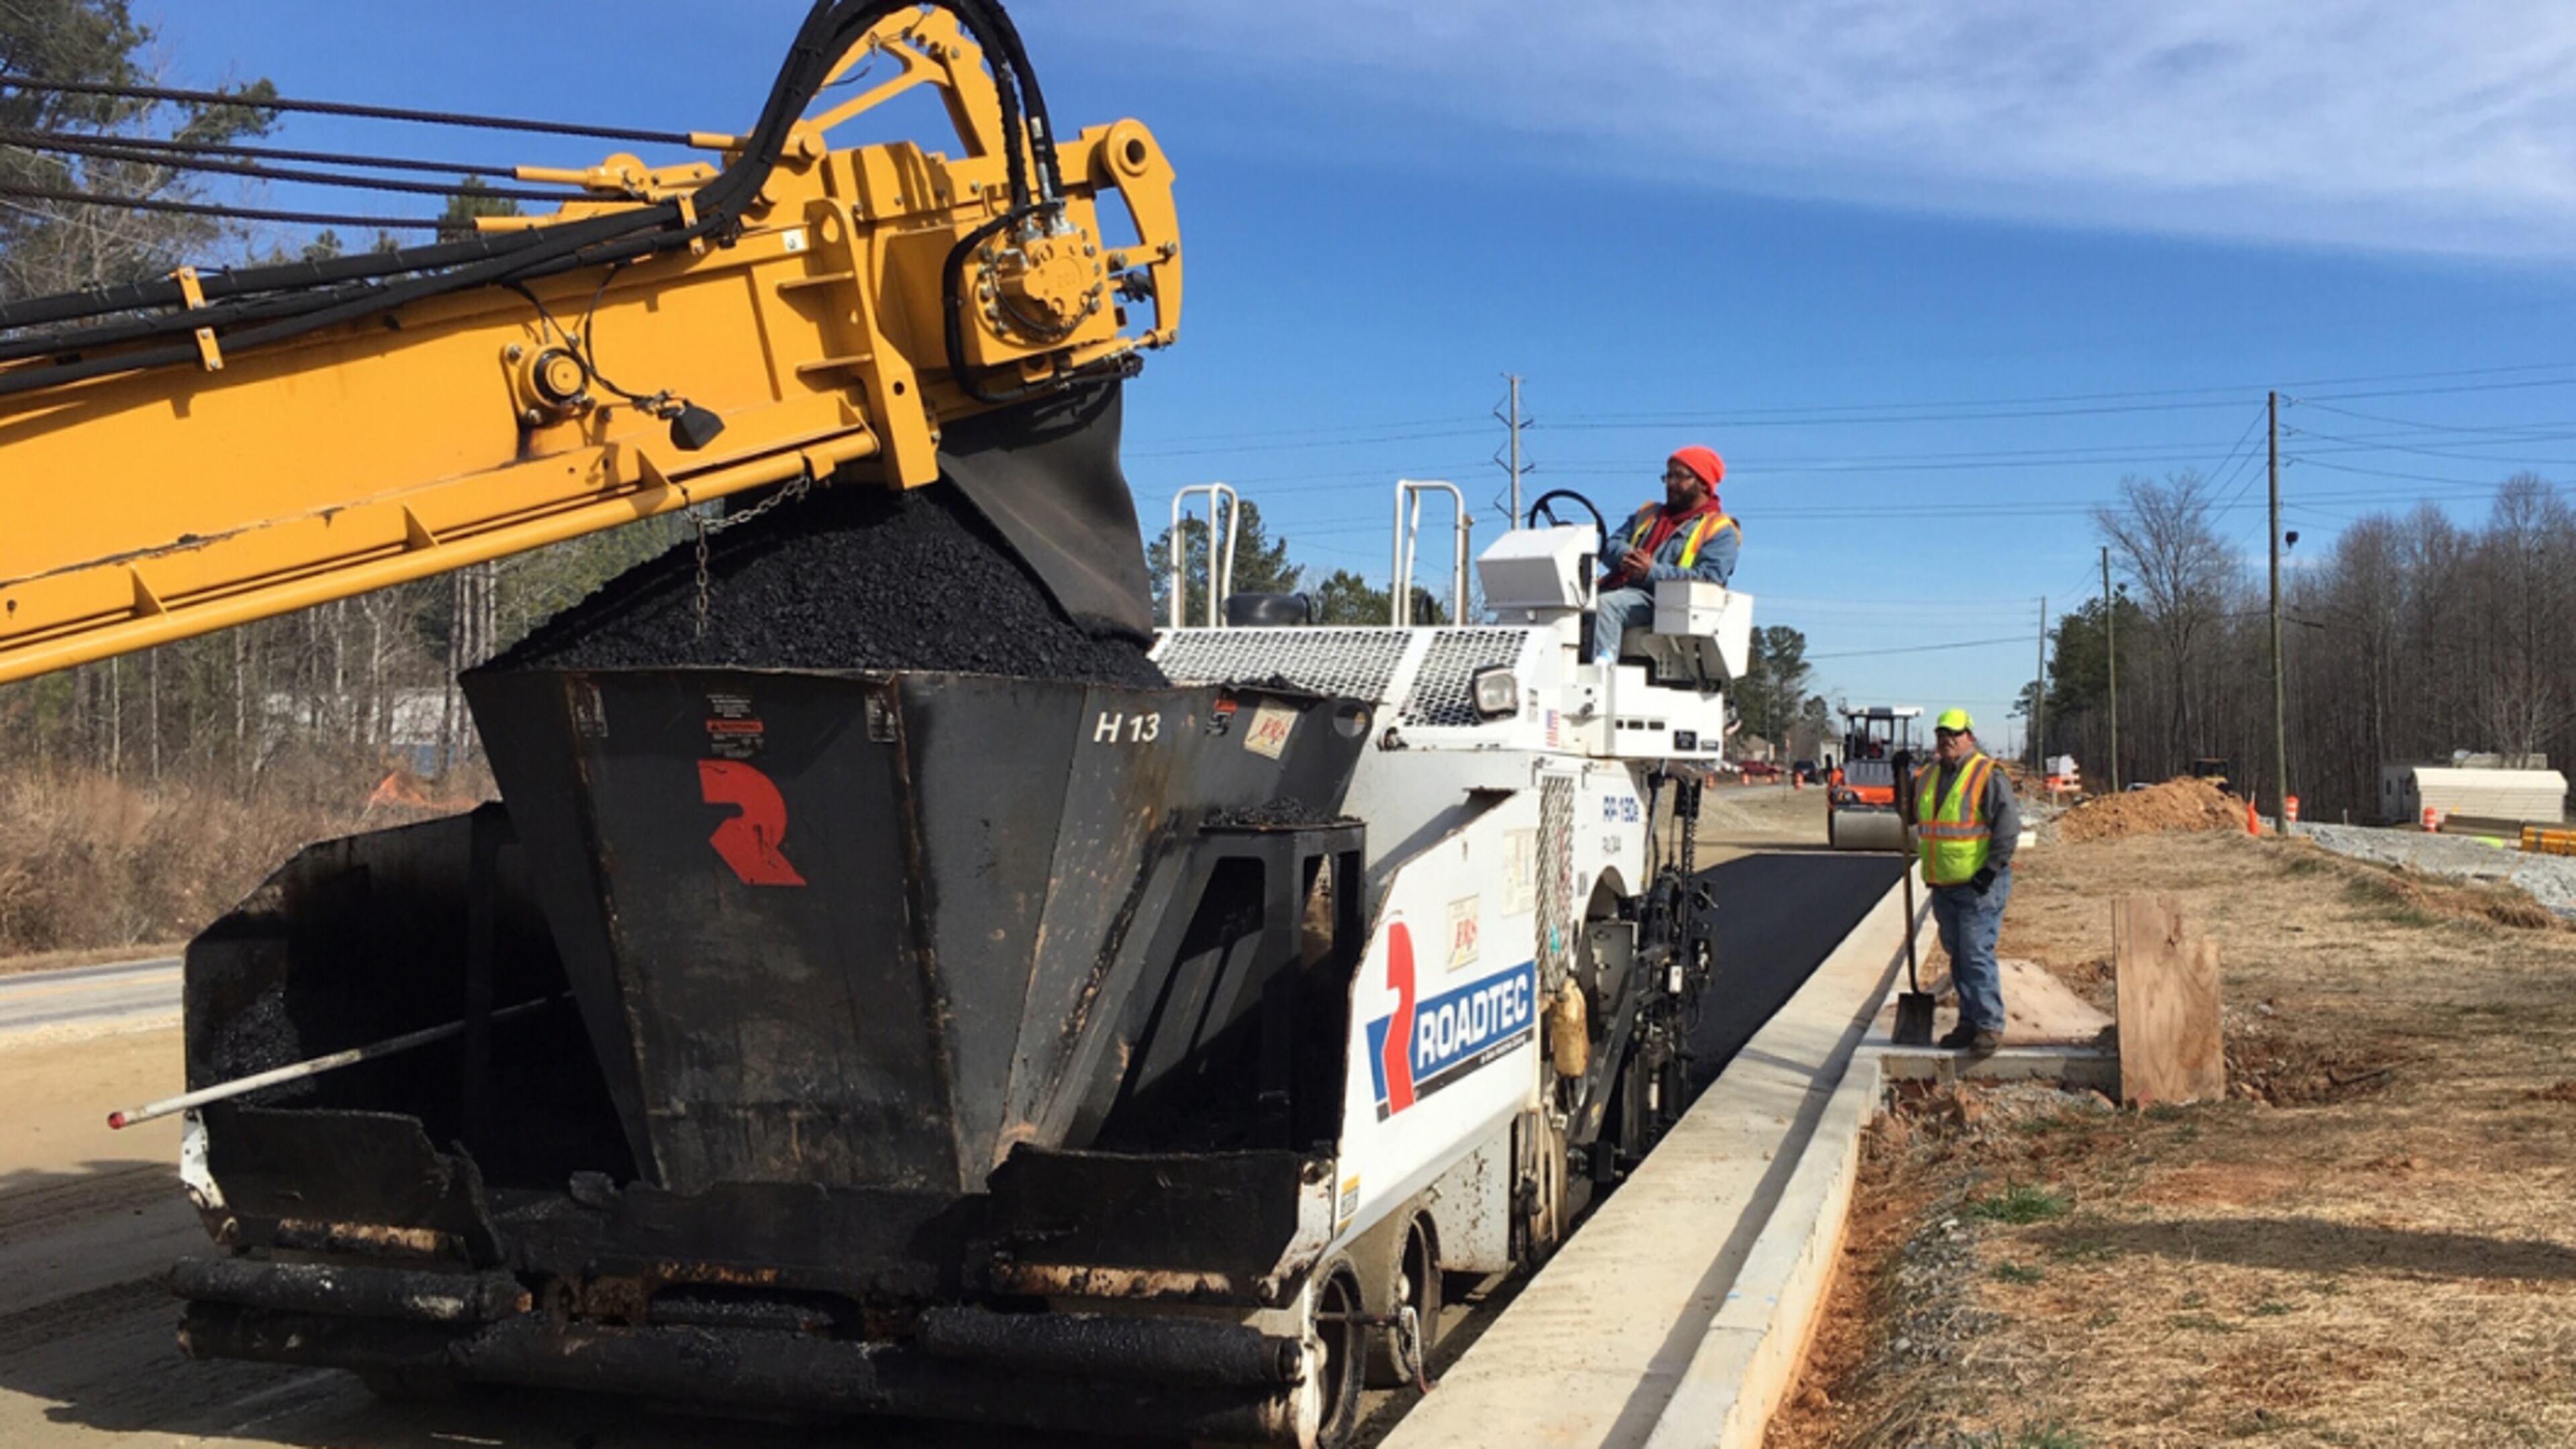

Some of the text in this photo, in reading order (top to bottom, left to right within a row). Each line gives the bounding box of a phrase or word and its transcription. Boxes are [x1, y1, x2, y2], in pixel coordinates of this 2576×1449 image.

[1093, 712, 1161, 743] H 13
[1417, 973, 1528, 1069] ROADTEC
